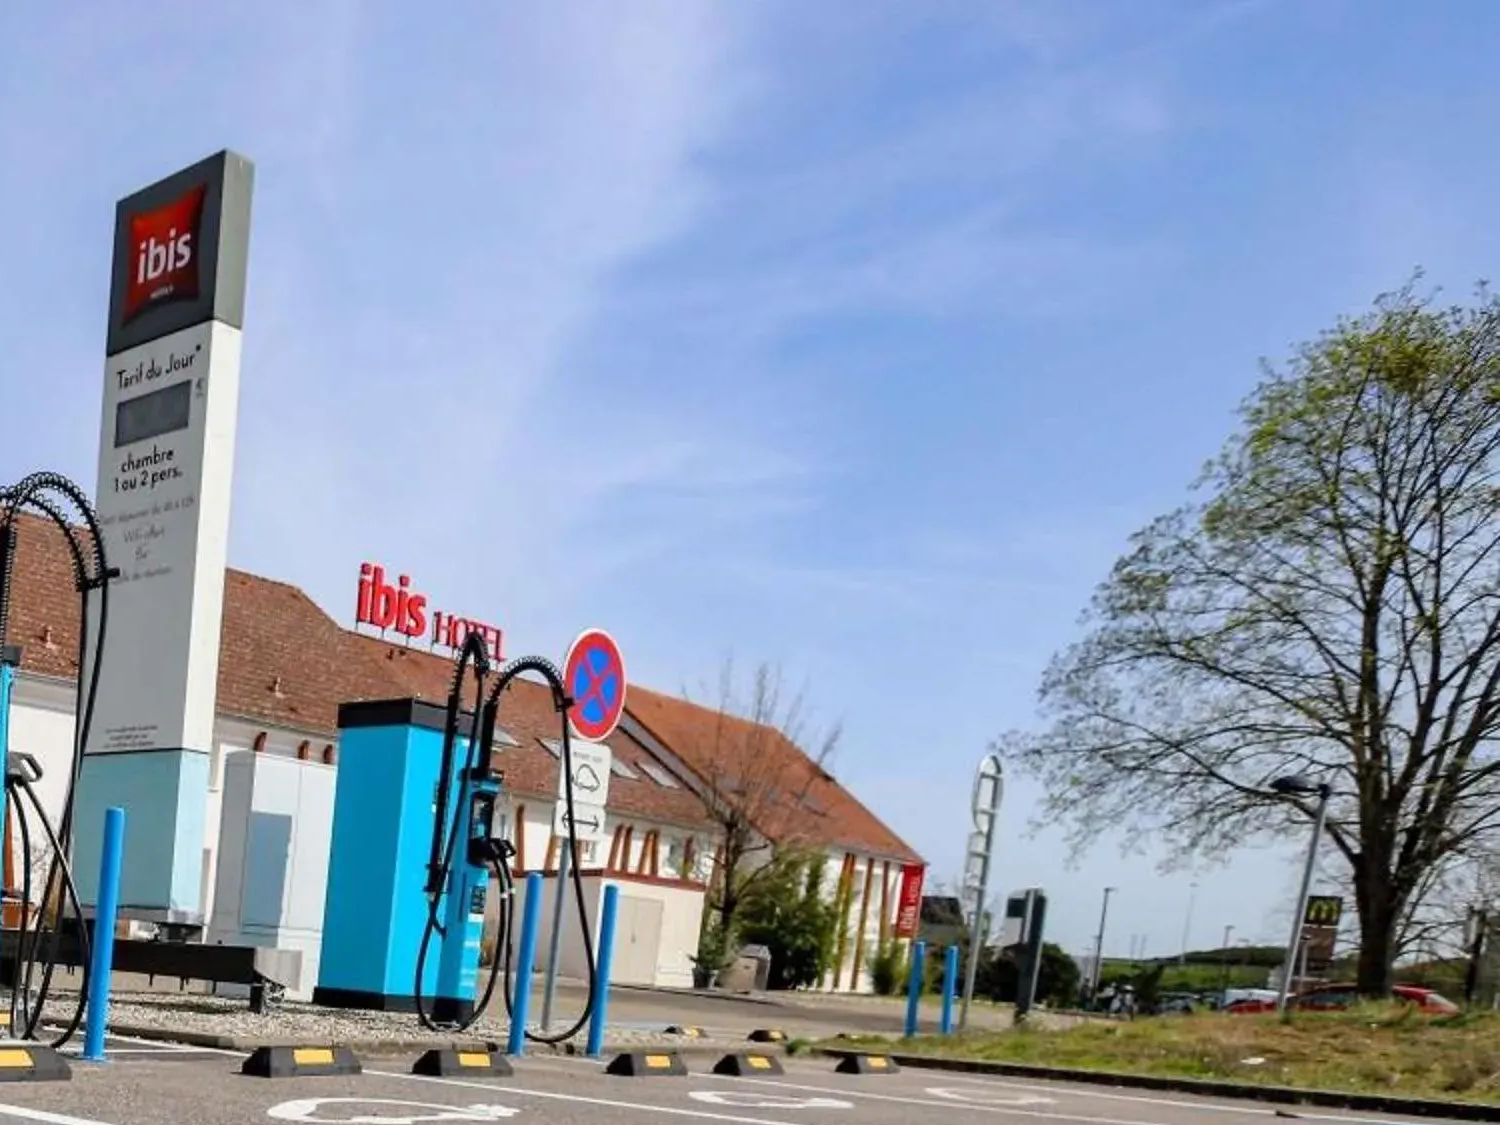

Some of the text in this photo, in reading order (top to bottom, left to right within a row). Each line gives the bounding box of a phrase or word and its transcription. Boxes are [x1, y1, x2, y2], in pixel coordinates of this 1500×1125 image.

[137, 228, 192, 284] ibis
[116, 361, 143, 390] Tarif
[146, 358, 162, 379] du
[121, 444, 174, 473] chambre
[122, 478, 137, 491] ou
[141, 470, 149, 487] 2
[151, 467, 183, 489] pers.
[357, 562, 427, 637] ibis
